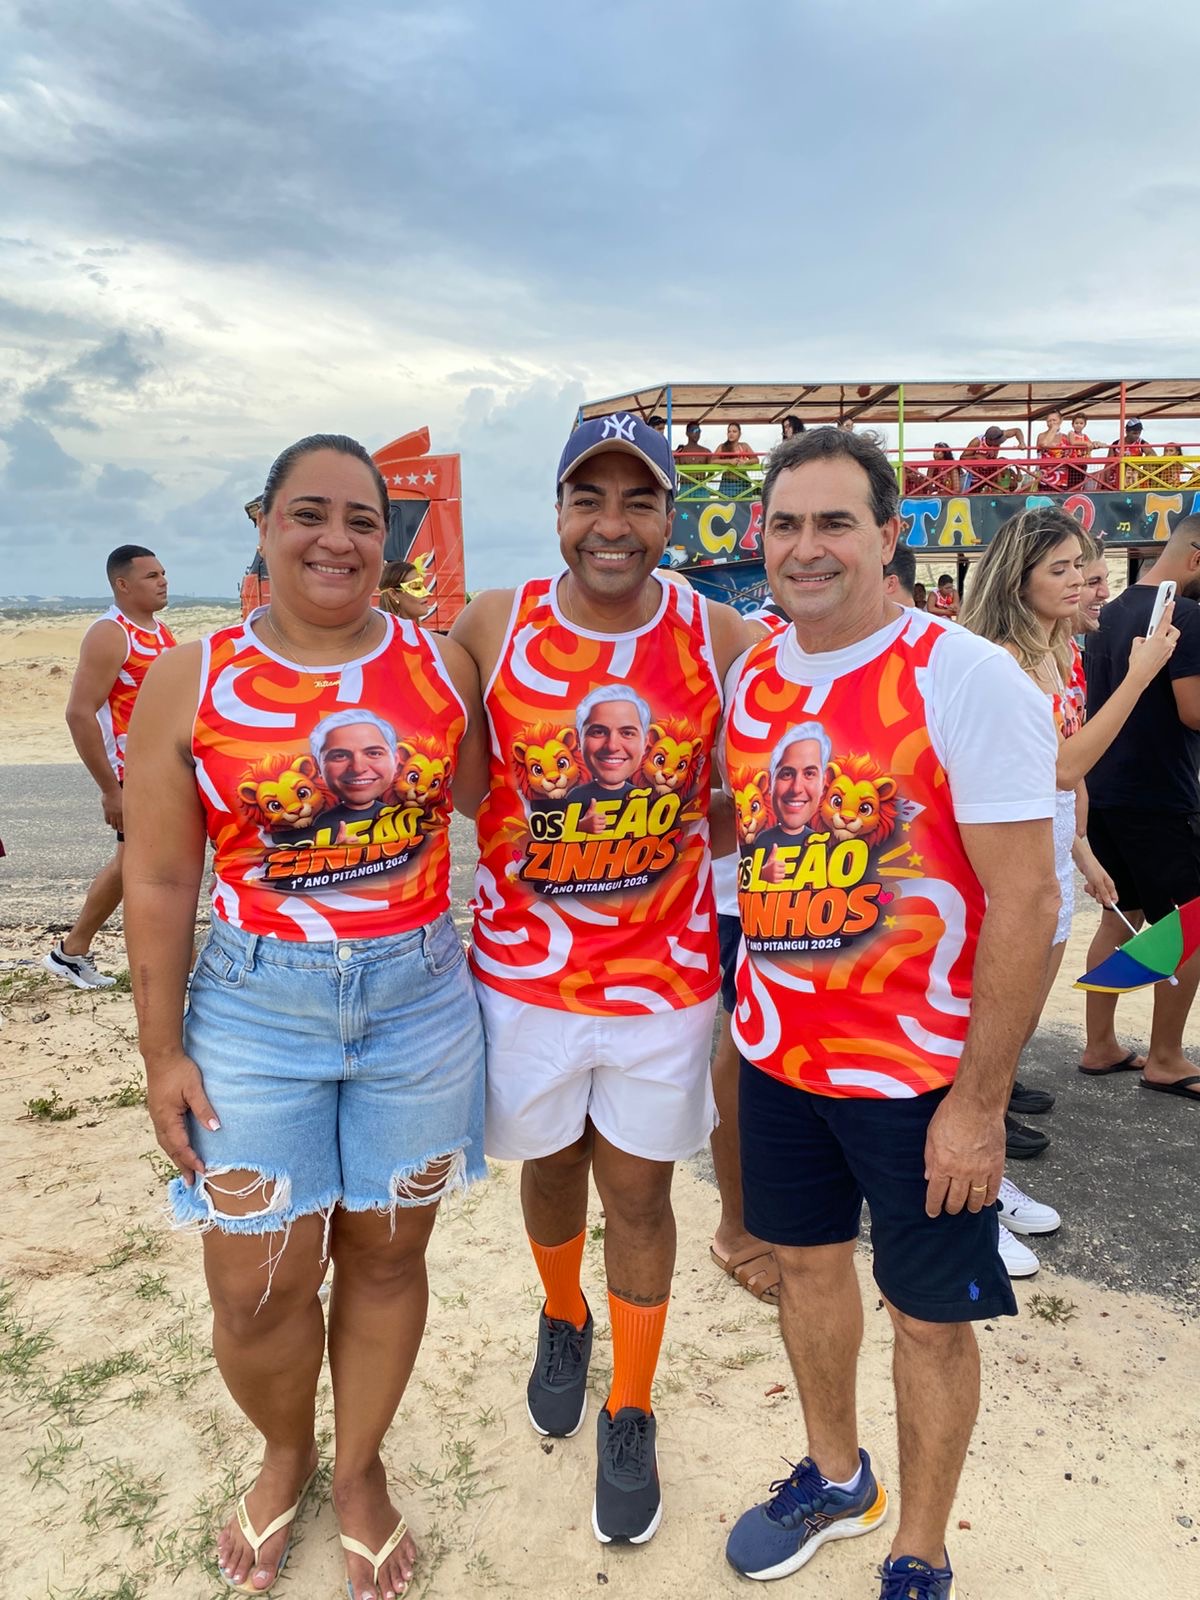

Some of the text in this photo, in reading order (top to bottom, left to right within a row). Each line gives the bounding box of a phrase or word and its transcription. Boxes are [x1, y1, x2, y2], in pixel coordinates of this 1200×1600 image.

[529, 787, 681, 843] OS LEÃO
[304, 875, 330, 888] ANO
[331, 862, 384, 883] PITANGUI
[385, 852, 409, 870] 2026
[523, 829, 681, 883] ZINHOS
[749, 832, 869, 892] LEÃO
[551, 884, 574, 895] ANO
[575, 880, 622, 893] PITANGUI
[623, 875, 649, 888] 2026
[763, 940, 808, 951] PITANGUI
[811, 938, 841, 950] 2026
